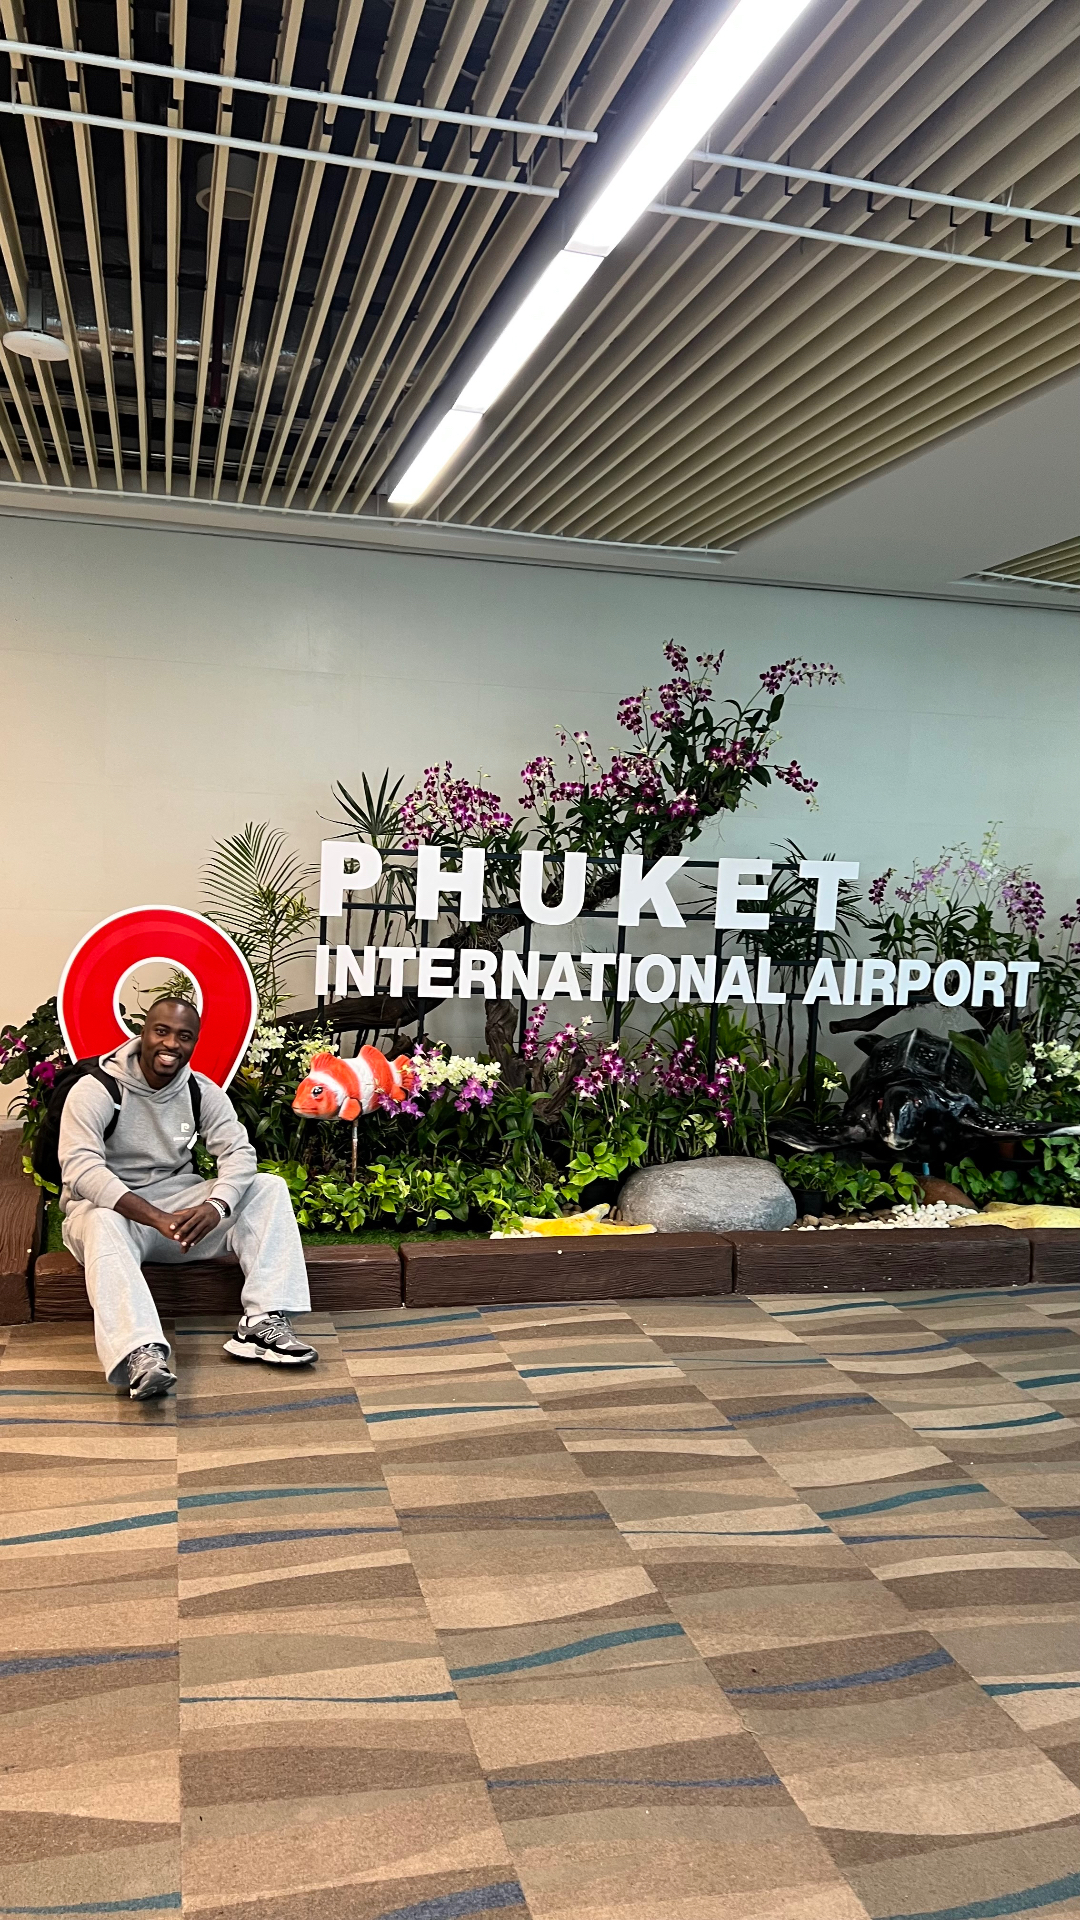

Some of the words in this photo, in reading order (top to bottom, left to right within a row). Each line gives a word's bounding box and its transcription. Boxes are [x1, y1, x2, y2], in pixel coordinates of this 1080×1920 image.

[318, 840, 860, 931] PHUKET
[314, 944, 787, 1005] INTERNATIONAL
[801, 957, 1040, 1007] AIRPORT
